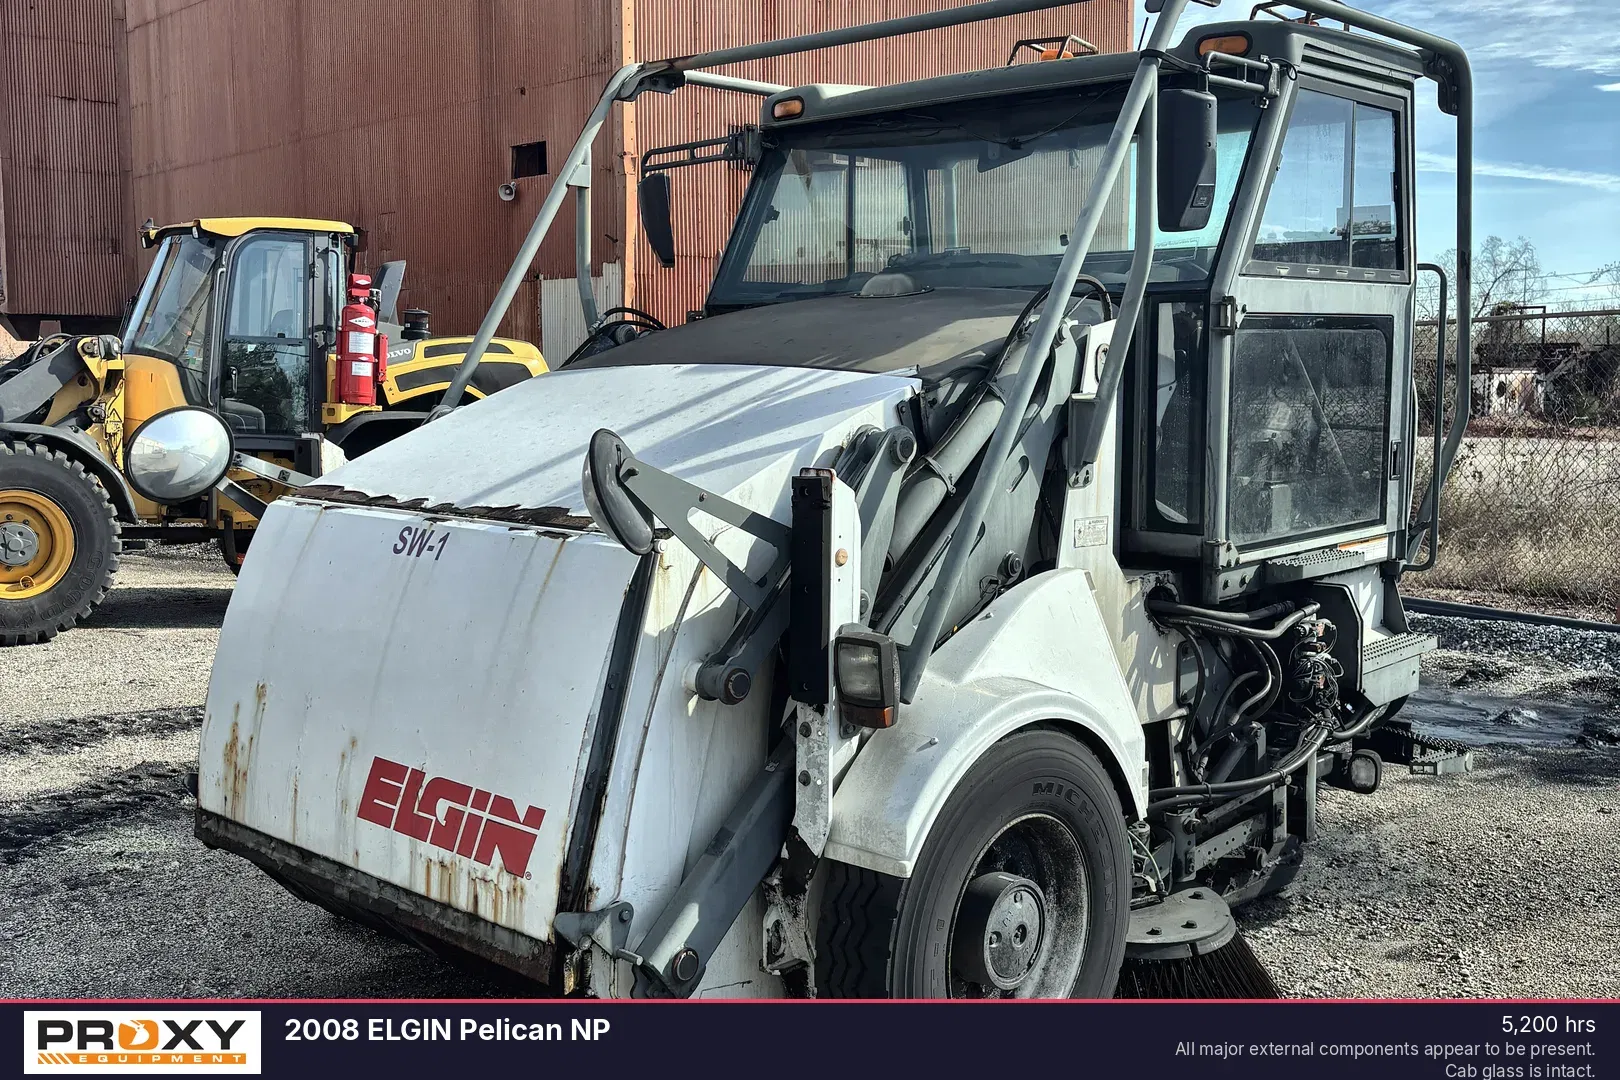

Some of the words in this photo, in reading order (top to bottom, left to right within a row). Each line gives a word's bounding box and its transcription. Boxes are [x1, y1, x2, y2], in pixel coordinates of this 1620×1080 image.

[392, 525, 451, 561] SW-1
[357, 756, 547, 879] ELGIN
[1031, 780, 1115, 913] MICHELIN
